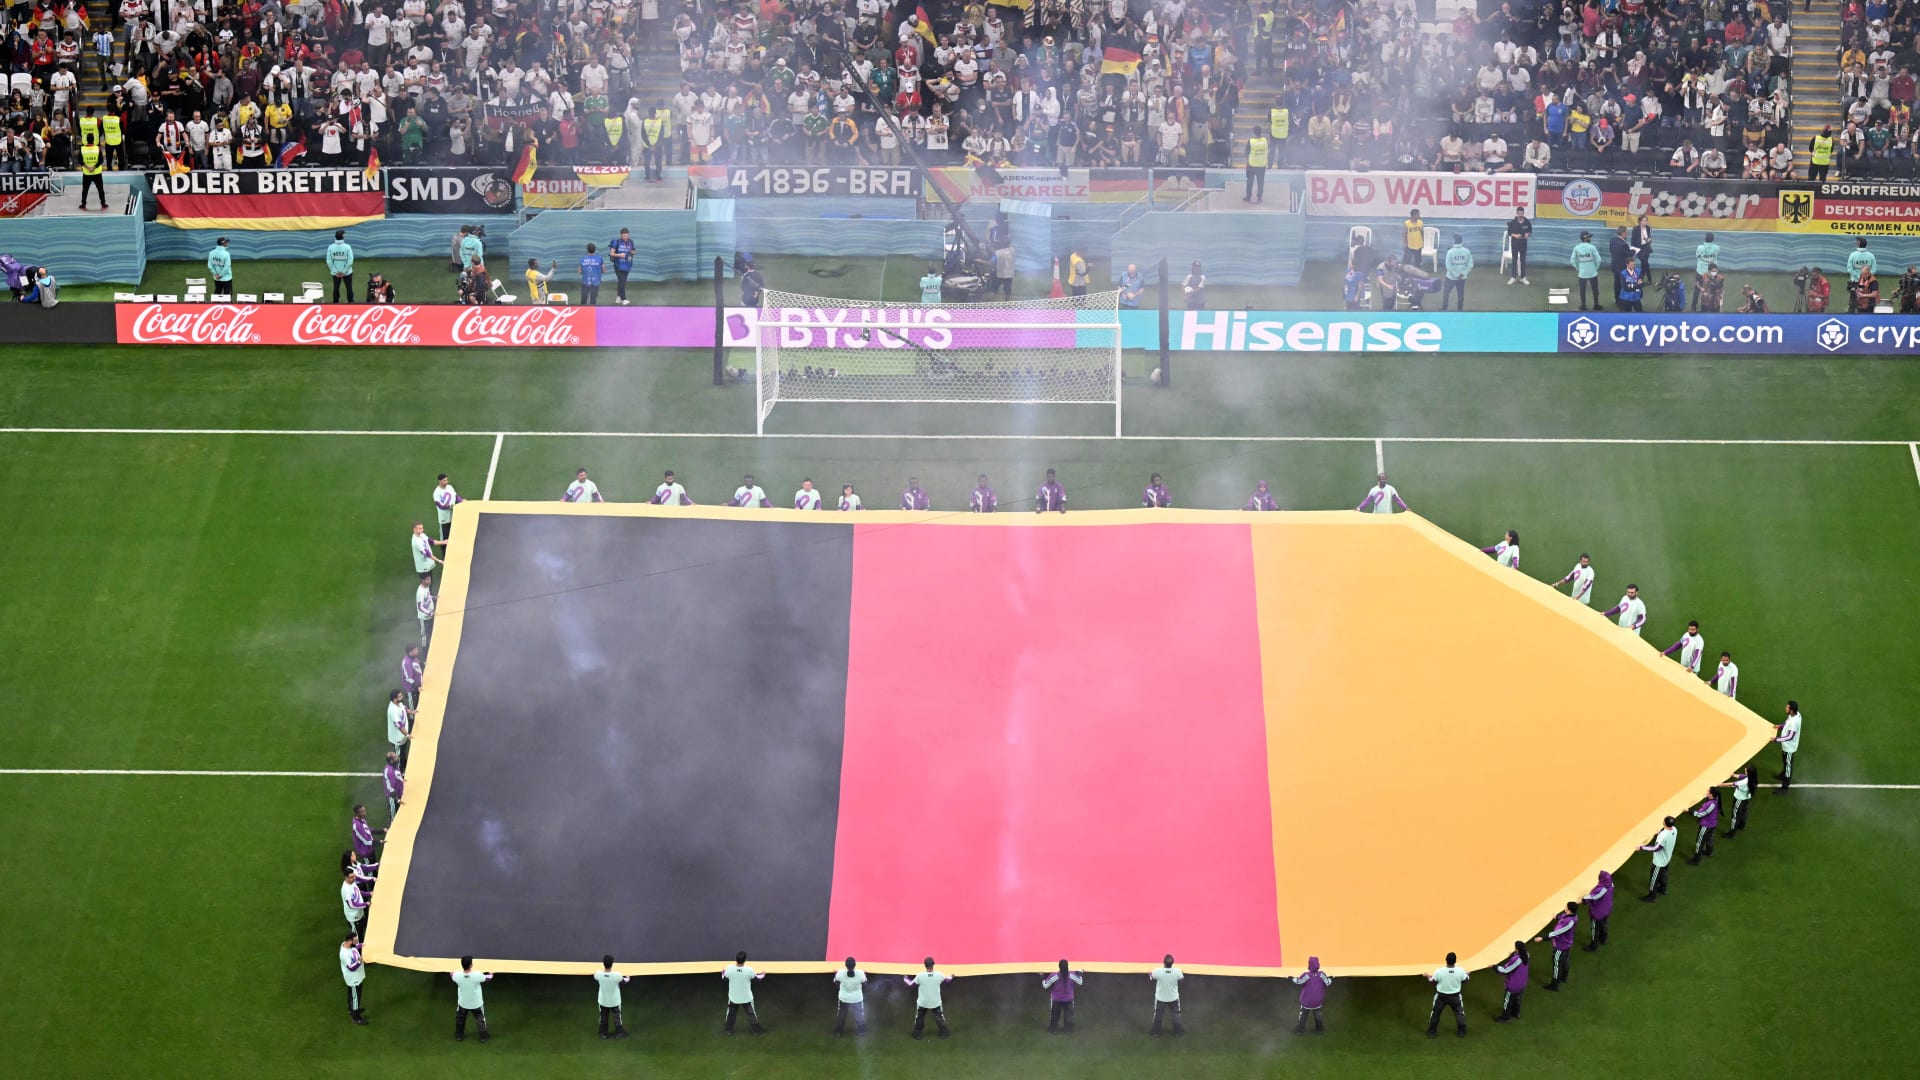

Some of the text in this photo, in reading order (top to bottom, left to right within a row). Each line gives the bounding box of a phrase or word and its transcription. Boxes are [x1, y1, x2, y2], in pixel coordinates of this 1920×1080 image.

[2, 175, 49, 191] HEIM
[152, 170, 381, 194] ADLER BRETTEN
[392, 176, 465, 201] SMD
[525, 179, 584, 194] PROHN
[970, 184, 1089, 197] NECKARELZ
[1311, 176, 1530, 207] BAD WALDSEE
[1610, 209, 1626, 217] Tour
[1830, 222, 1902, 231] GEKOMMEN
[132, 304, 260, 343] Coca-Cola
[292, 305, 420, 345] Coca-Cola
[451, 306, 580, 345] Coca-Cola
[780, 308, 953, 349] BYJU'S
[1180, 310, 1442, 352] Hisense
[1609, 320, 1783, 347] crypto.com
